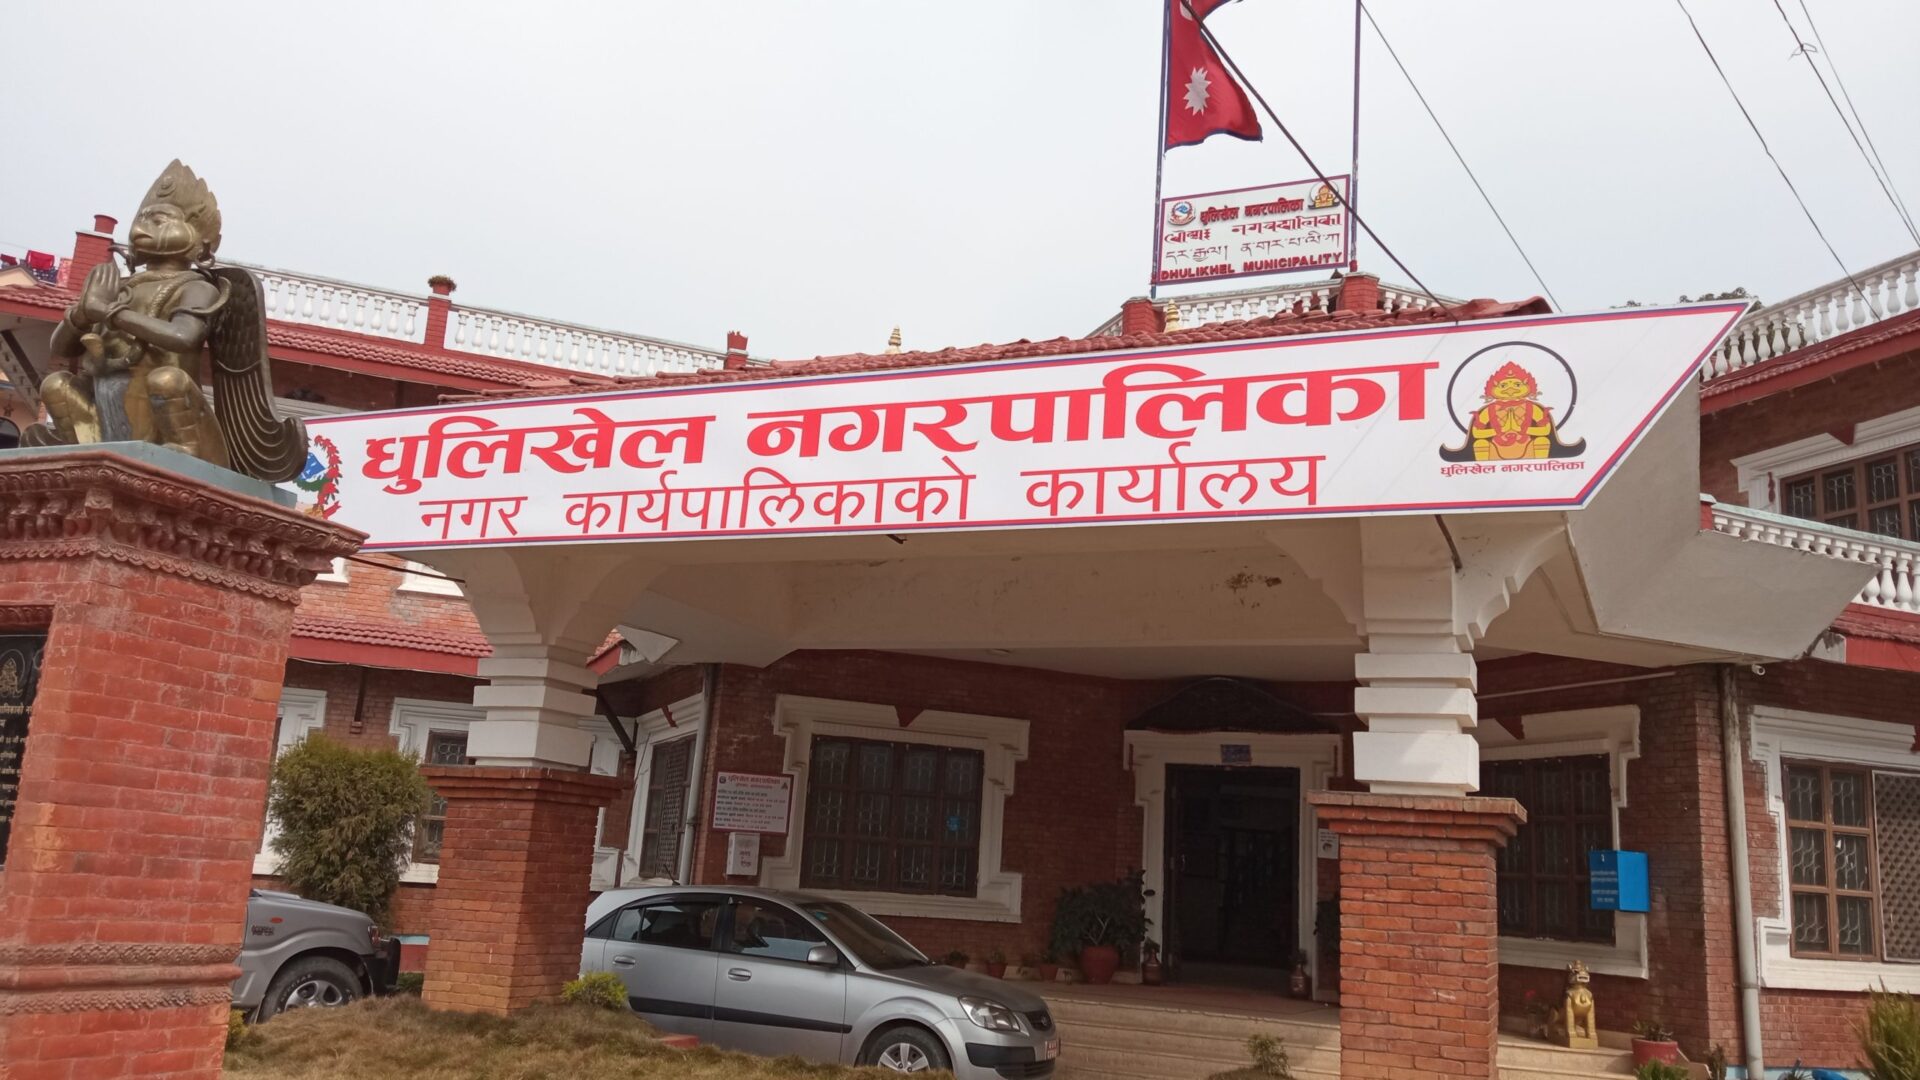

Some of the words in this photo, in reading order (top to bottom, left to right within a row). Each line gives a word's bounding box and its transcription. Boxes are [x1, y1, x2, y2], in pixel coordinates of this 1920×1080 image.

[1199, 205, 1240, 225] धुलिखेल
[1244, 197, 1305, 217] नगरपालिका
[1161, 264, 1235, 280] DHULIKHEL
[1243, 252, 1343, 272] MUNICIPALITY
[362, 407, 716, 495] धुलिखेल
[746, 363, 1440, 458] नगरपालिका
[1440, 463, 1496, 477] धुलिखेल
[1501, 461, 1585, 473] नगरपालिका
[418, 496, 528, 540] नगर
[563, 456, 977, 534] कार्यपालिकाको
[1020, 441, 1327, 517] कार्यालय
